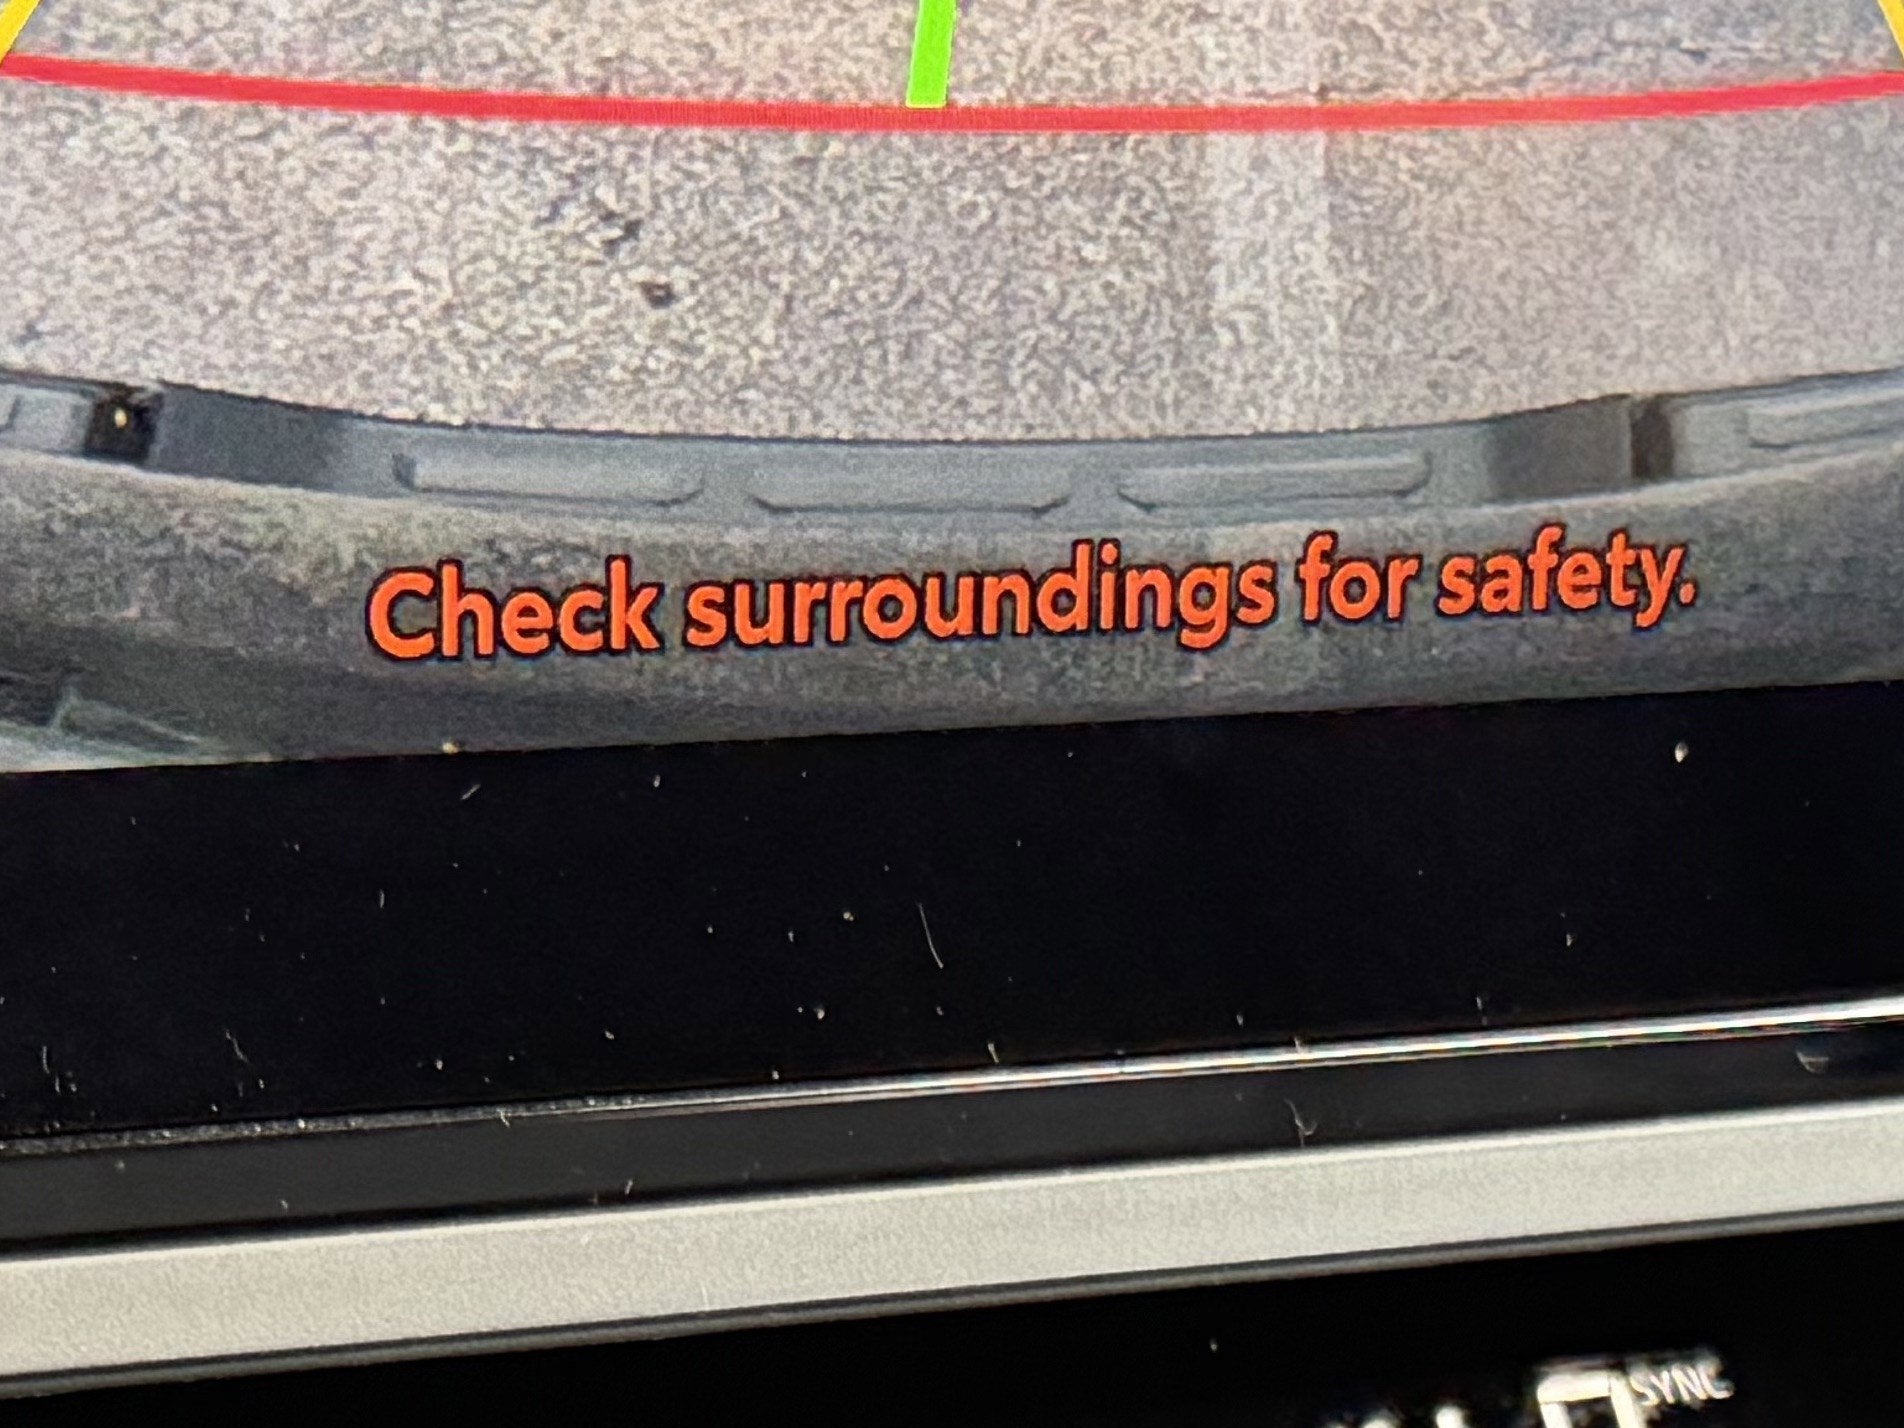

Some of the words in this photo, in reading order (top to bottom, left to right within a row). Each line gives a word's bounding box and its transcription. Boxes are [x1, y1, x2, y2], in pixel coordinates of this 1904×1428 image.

[367, 556, 660, 661] Check
[683, 541, 1278, 651] surroundings
[1296, 532, 1421, 622] for
[1437, 524, 1697, 629] safety.
[1629, 1360, 1736, 1406] SYNC
